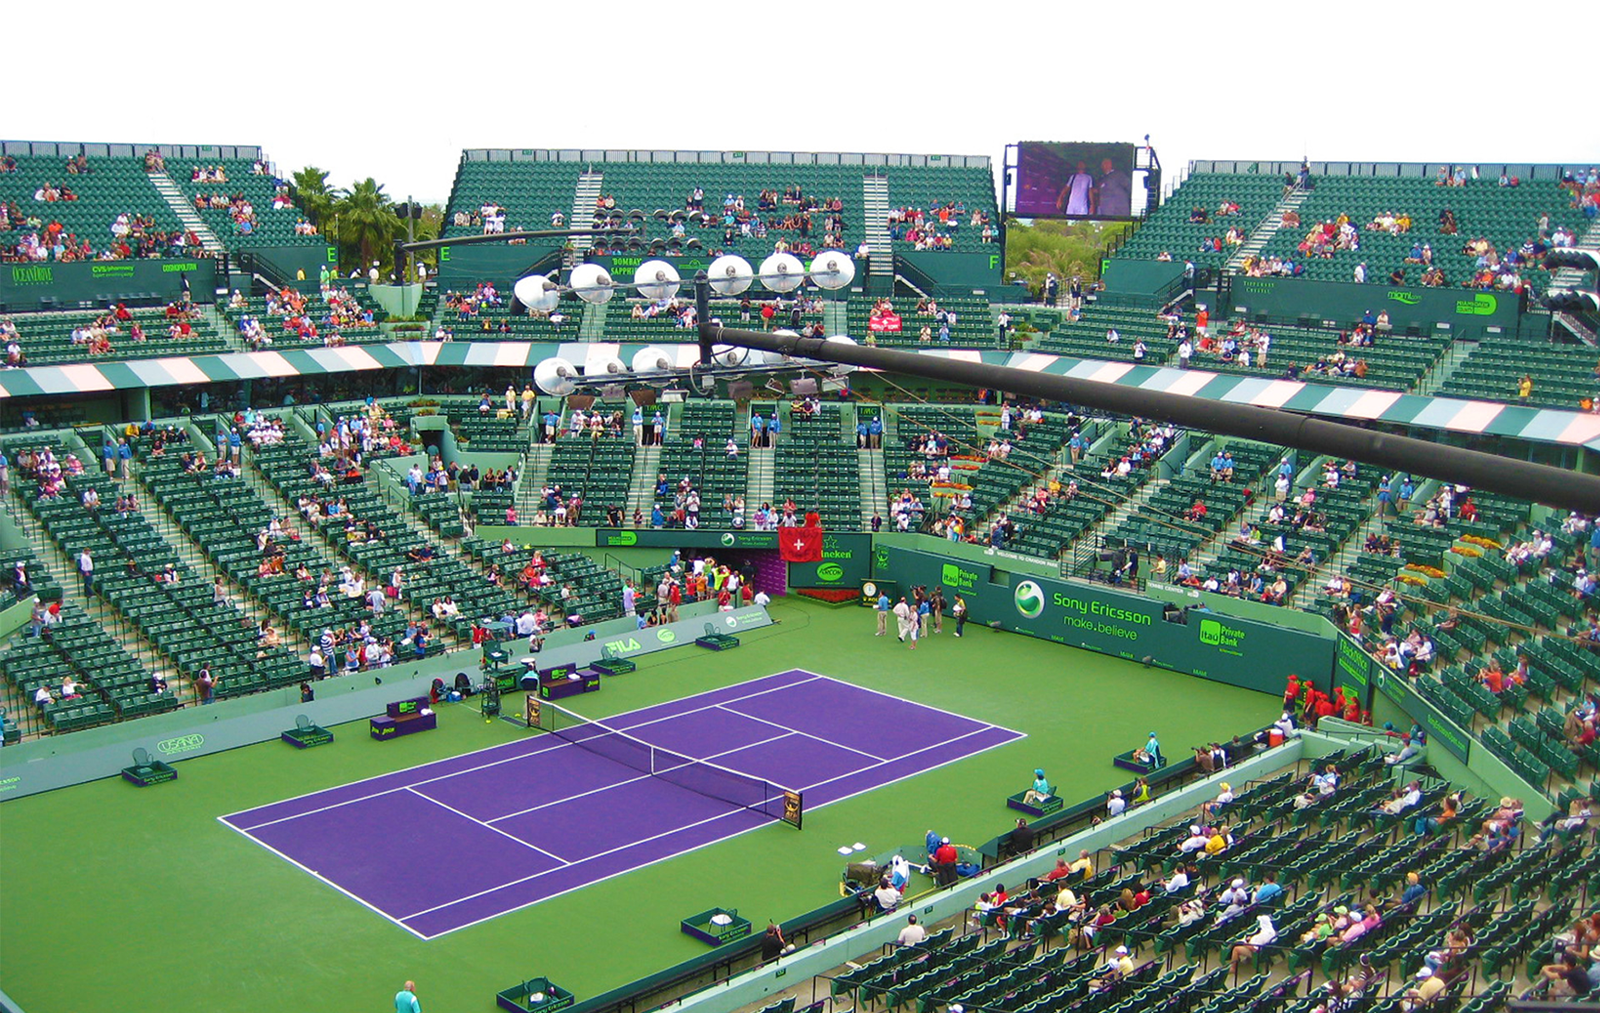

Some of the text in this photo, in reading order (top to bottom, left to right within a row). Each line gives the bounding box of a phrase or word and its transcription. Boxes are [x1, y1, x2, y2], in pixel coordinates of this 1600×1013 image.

[327, 247, 338, 262] E
[440, 246, 451, 261] E
[989, 255, 999, 269] F
[1101, 260, 1111, 275] F
[610, 267, 638, 275] SAPPHI
[821, 549, 852, 559] ineken
[1053, 592, 1152, 626] Sony Ericsson
[1221, 625, 1246, 640] Private
[604, 638, 642, 654] FILA
[1220, 635, 1240, 647] Bank
[161, 735, 201, 751] USANA
